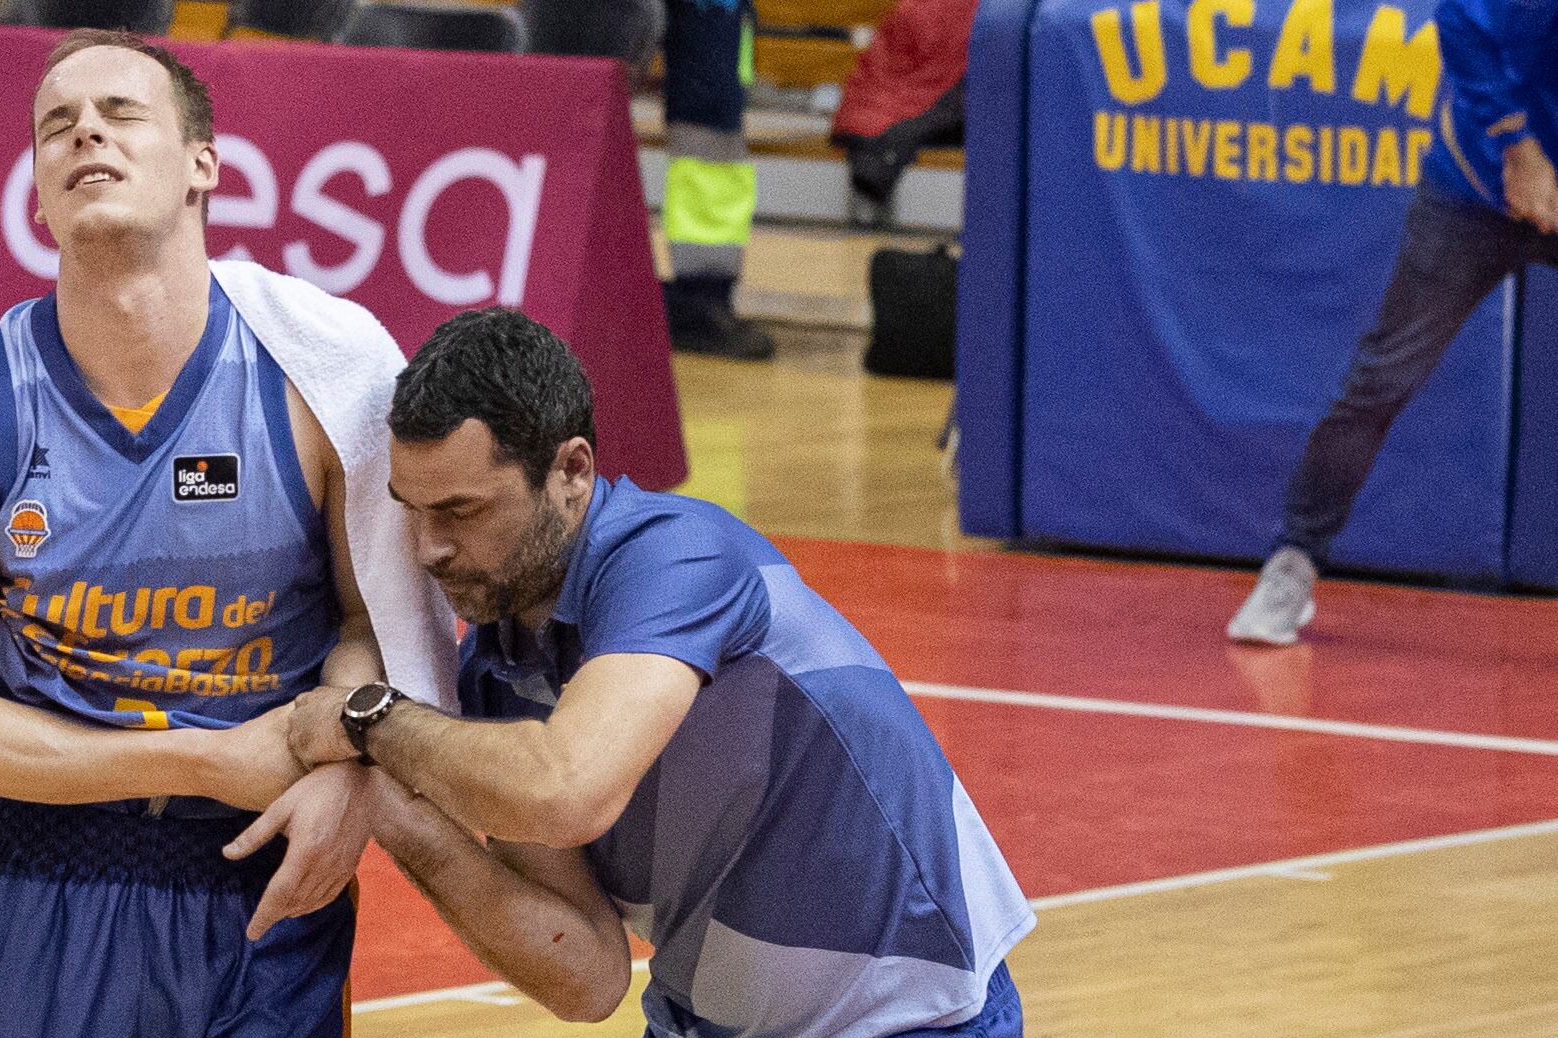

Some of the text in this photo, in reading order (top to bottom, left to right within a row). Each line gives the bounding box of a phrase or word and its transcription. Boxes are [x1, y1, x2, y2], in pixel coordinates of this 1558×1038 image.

[1091, 0, 1441, 119] UCAM
[178, 468, 205, 485] liga
[178, 481, 236, 496] endesa
[222, 592, 275, 628] del
